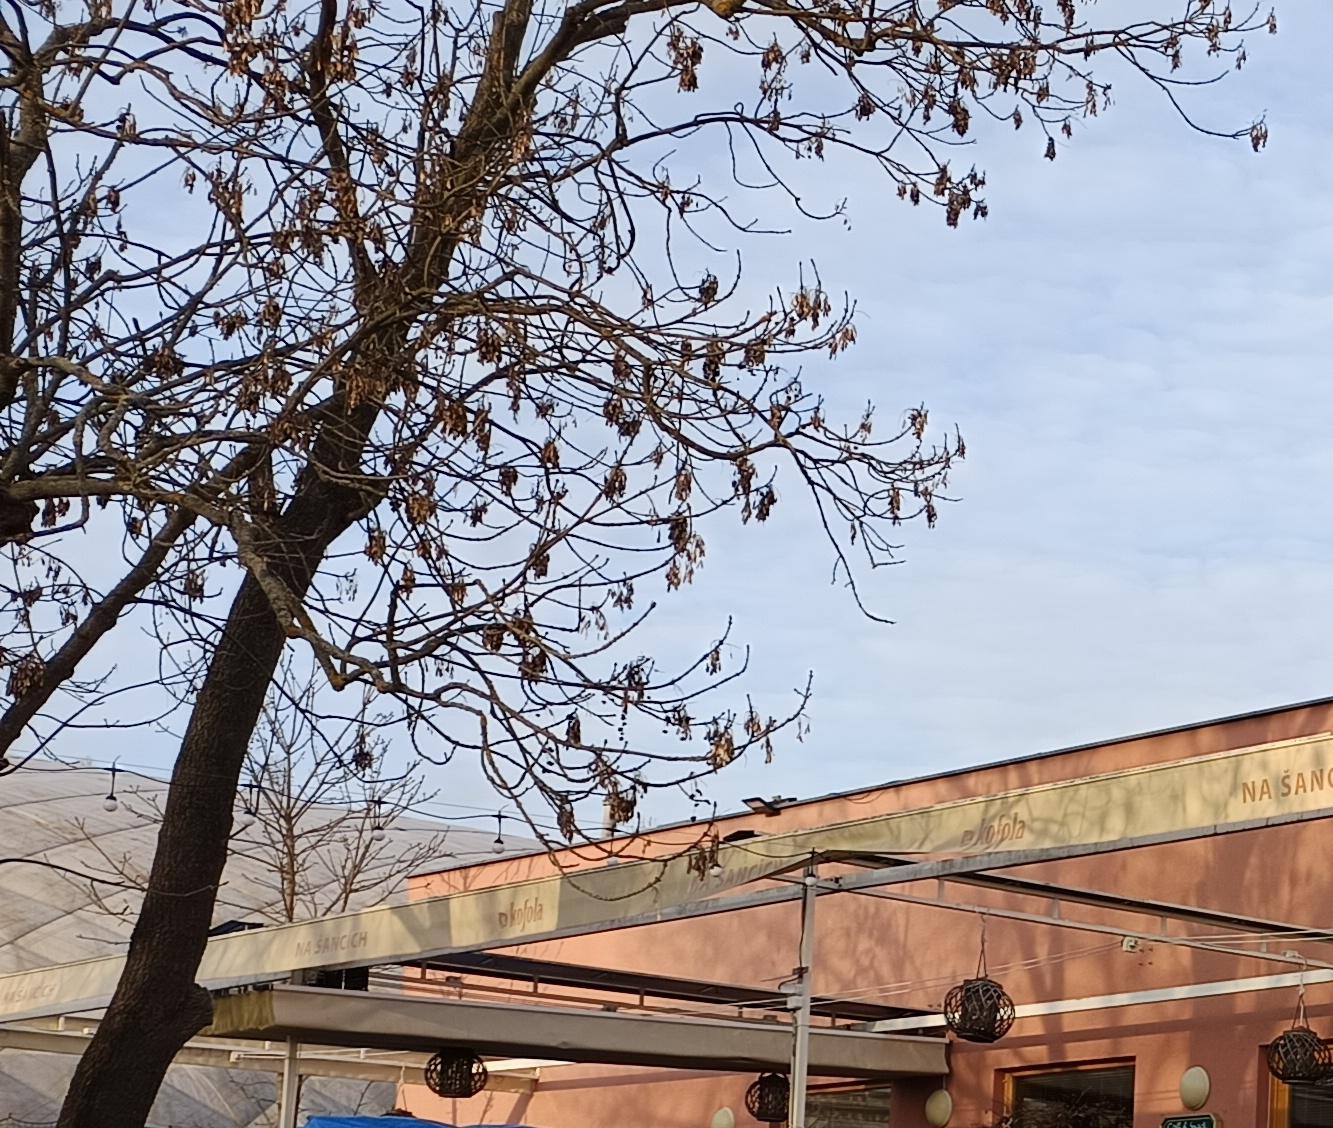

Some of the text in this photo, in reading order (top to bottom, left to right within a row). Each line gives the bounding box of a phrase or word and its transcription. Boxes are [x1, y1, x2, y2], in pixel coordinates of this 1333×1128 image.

[1241, 778, 1272, 804] NA
[973, 812, 1026, 849] kofola
[510, 896, 544, 932] kofola
